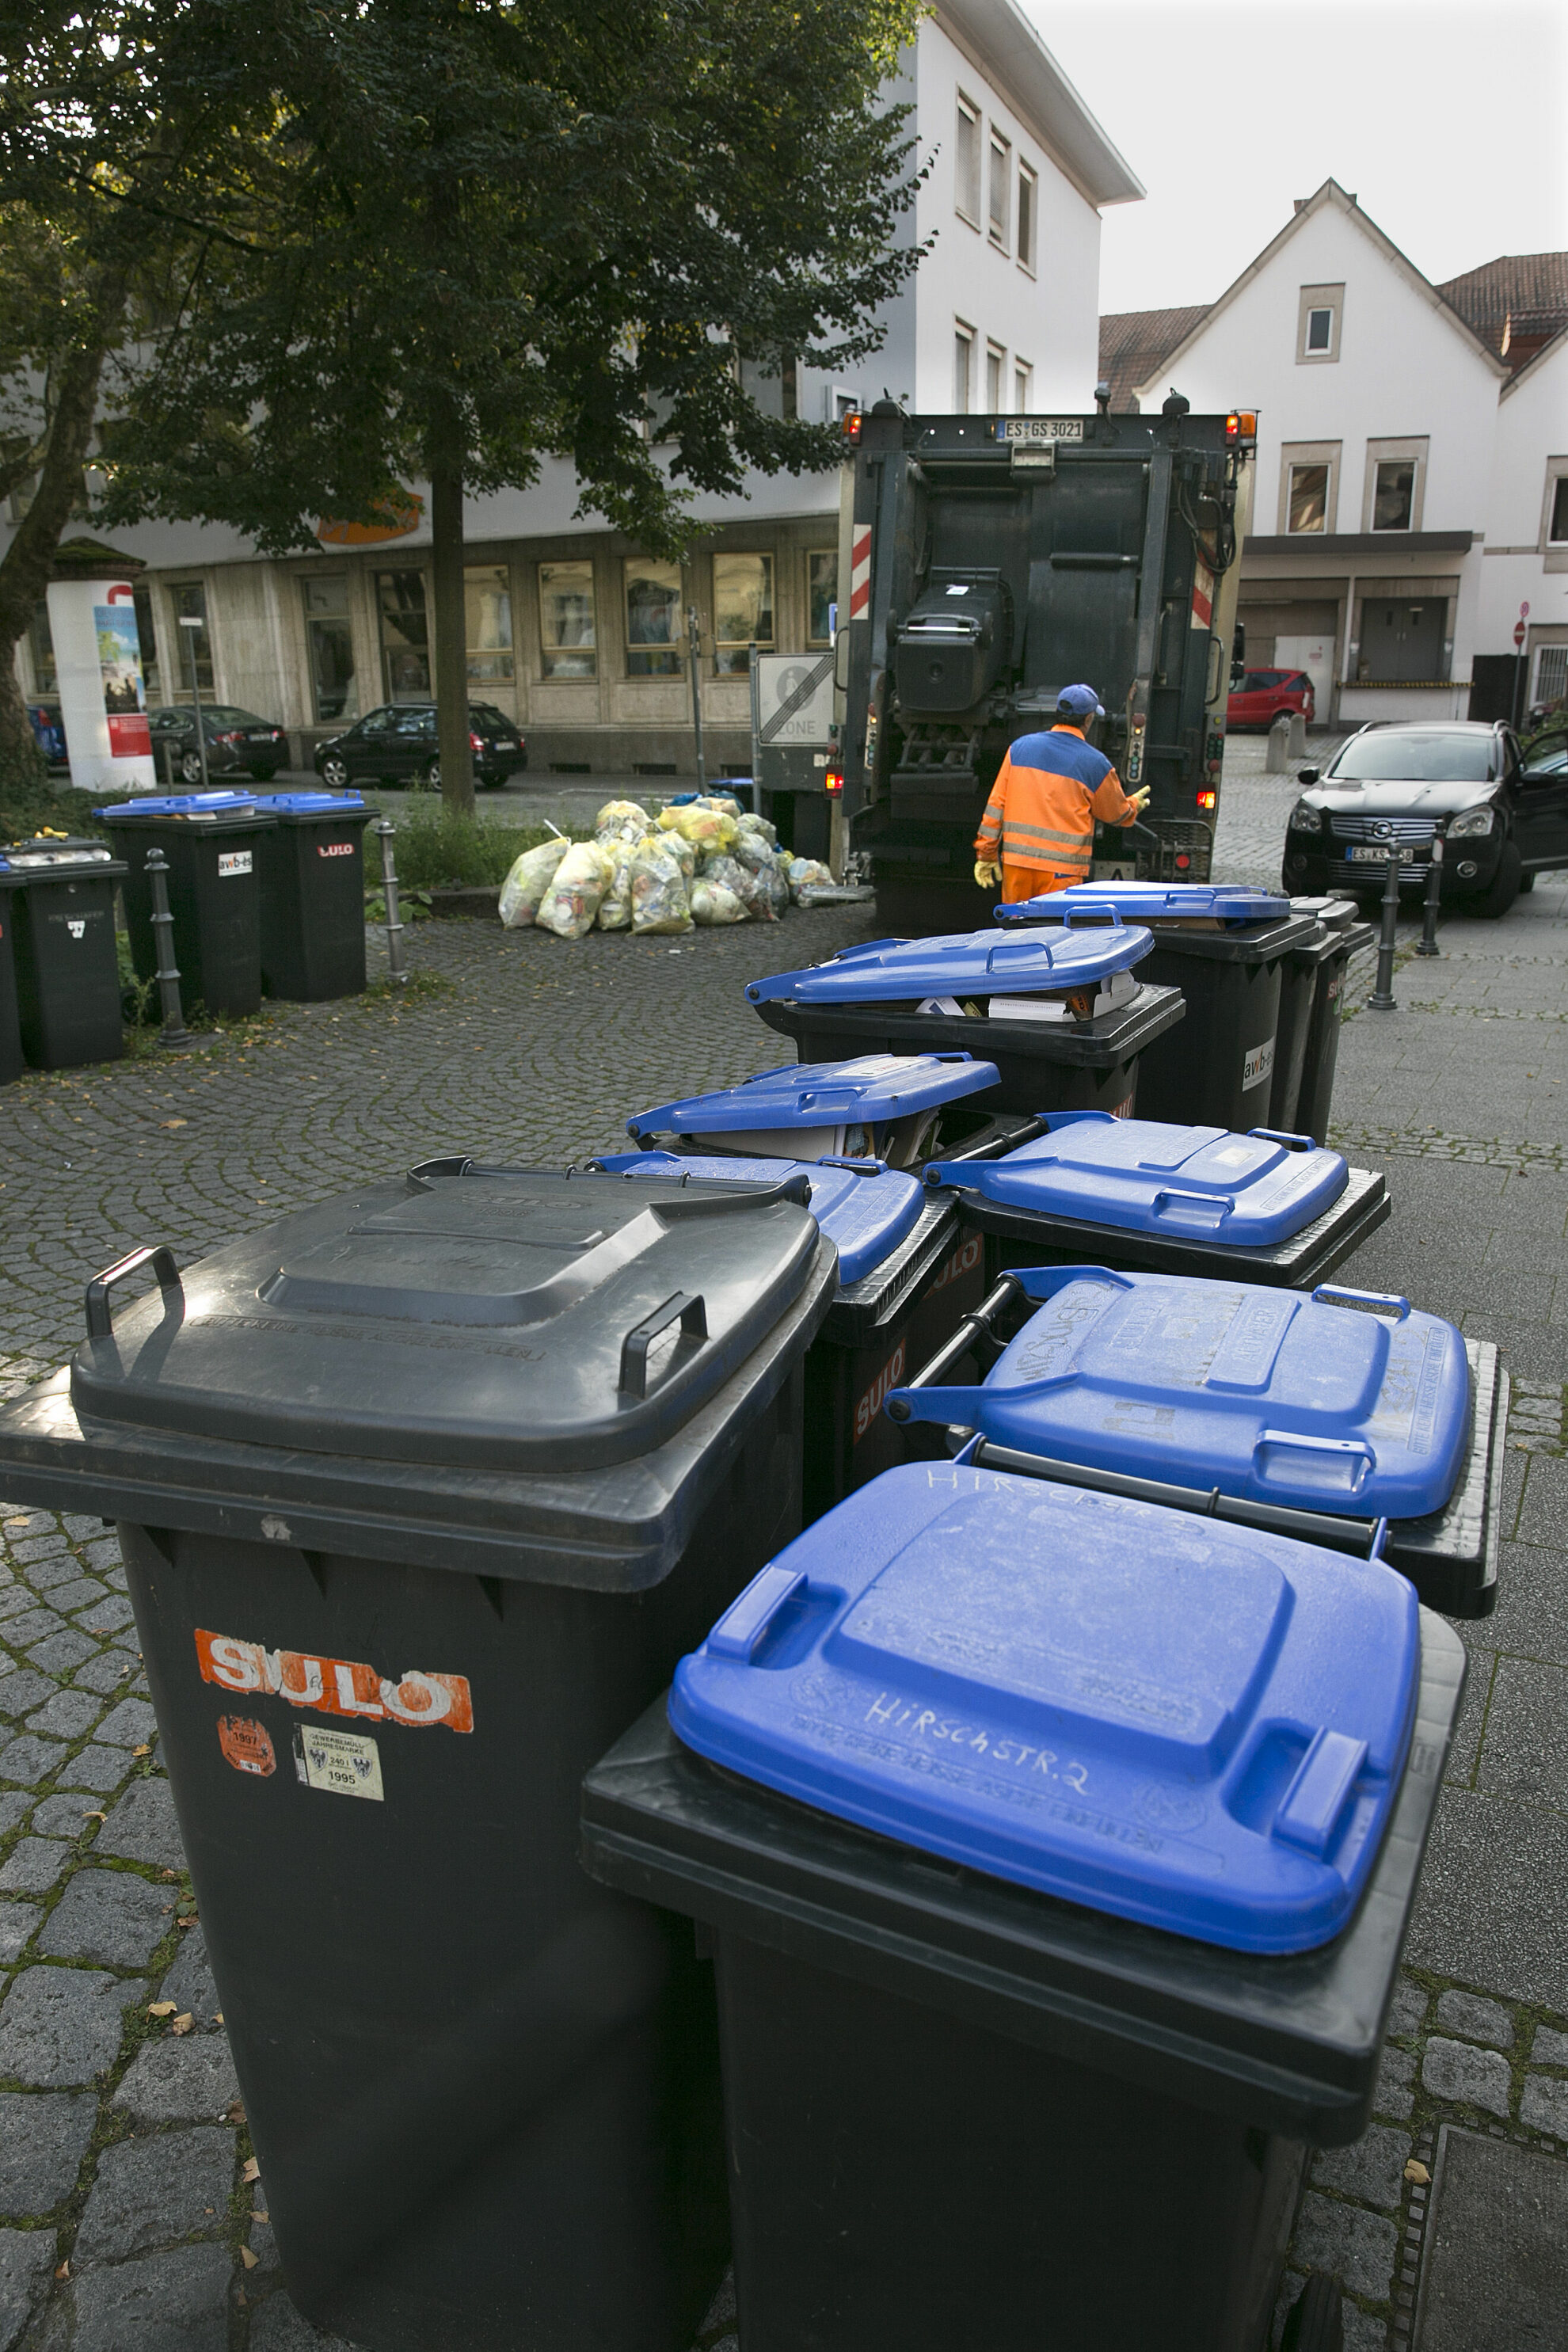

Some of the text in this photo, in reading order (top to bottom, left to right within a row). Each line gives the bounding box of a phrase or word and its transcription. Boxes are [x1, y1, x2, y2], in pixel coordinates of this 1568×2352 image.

[1007, 422, 1082, 437] ES GS 3021
[1353, 849, 1366, 860] ES
[1372, 849, 1386, 861] KS
[934, 1239, 979, 1289] ULO
[857, 1347, 903, 1435] SULO
[209, 1638, 452, 1722] SULO
[233, 1731, 257, 1745] 1997
[329, 1756, 344, 1766] 240
[328, 1771, 356, 1785] 1995
